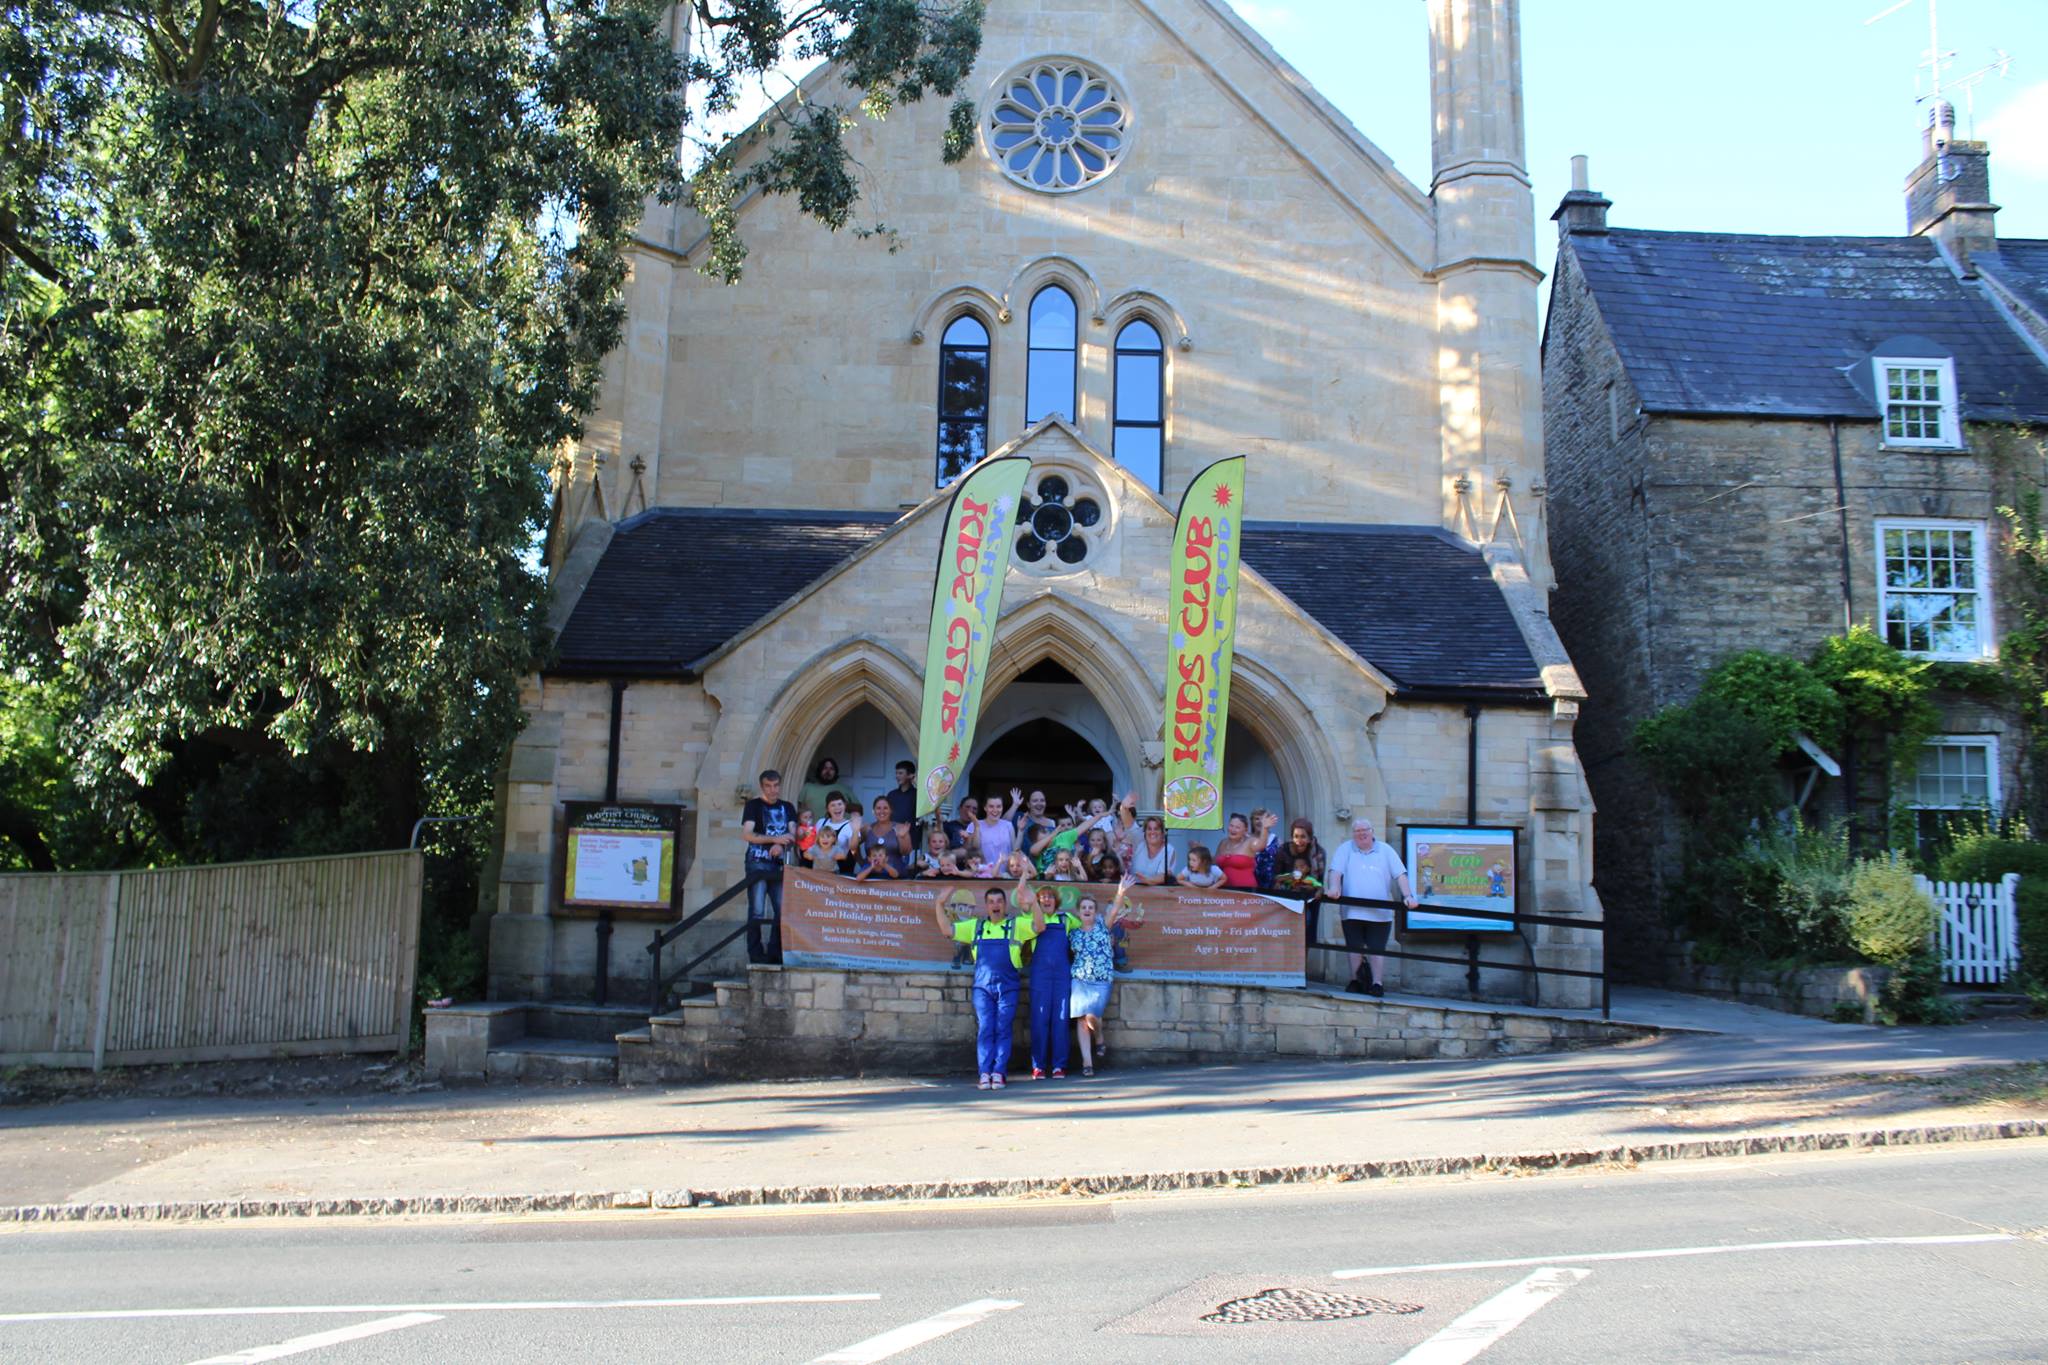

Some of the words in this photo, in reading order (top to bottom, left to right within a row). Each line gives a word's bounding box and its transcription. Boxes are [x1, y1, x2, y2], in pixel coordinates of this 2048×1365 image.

[1215, 518, 1231, 597] GOD
[1182, 516, 1213, 636] CLUB
[1173, 654, 1205, 764] KIDS
[586, 810, 622, 821] BAPTIST
[625, 811, 659, 823] CHURCH
[794, 880, 835, 894] Chipping
[836, 885, 866, 895] Norton
[869, 888, 900, 899] Baptist
[901, 890, 934, 900] Church
[825, 899, 854, 909] Invites
[855, 903, 872, 913] you
[874, 903, 883, 911] to
[1178, 896, 1201, 905] From
[1203, 897, 1235, 907] 2:00pm
[805, 909, 838, 919] Annual
[839, 911, 873, 924] Holiday
[875, 913, 898, 923] Bible
[899, 915, 922, 925] Club
[822, 926, 835, 935] Join
[880, 930, 904, 939] Games
[1162, 926, 1182, 935] Mon
[1184, 926, 1204, 937] 30th
[1205, 926, 1222, 938] July
[1230, 927, 1242, 935] Fri
[1244, 927, 1258, 938] 3rd
[1259, 927, 1291, 938] August
[863, 938, 877, 946] Lots
[878, 939, 886, 947] of
[886, 939, 900, 947] Fun
[1194, 944, 1213, 955] Age
[1233, 946, 1257, 956] years
